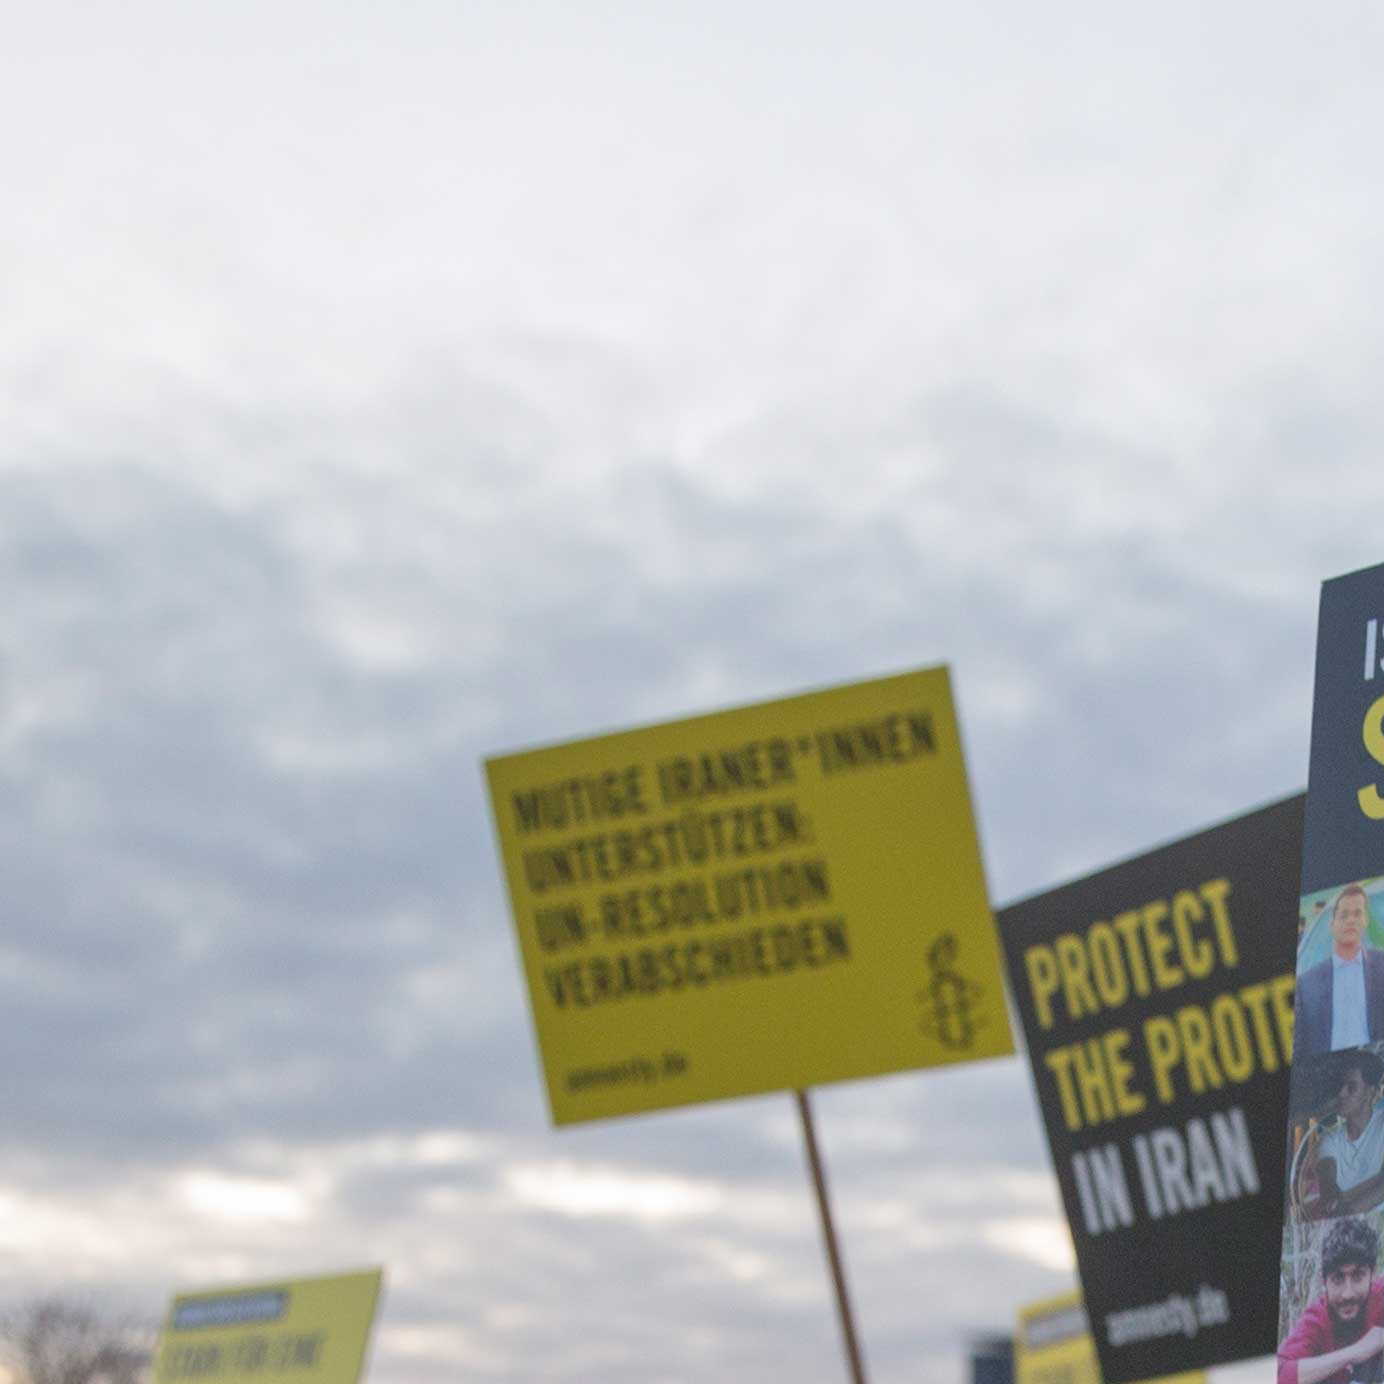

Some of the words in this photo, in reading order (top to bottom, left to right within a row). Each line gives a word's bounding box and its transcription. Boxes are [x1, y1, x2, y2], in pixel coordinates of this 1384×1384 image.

[511, 764, 647, 835] MUTIGE
[544, 917, 852, 1010] VERABSCHIEDEN
[1025, 878, 1238, 1031] PROTECT
[1045, 1028, 1146, 1133] THE
[1071, 1142, 1134, 1238] IN
[1133, 1107, 1261, 1221] IRAN
